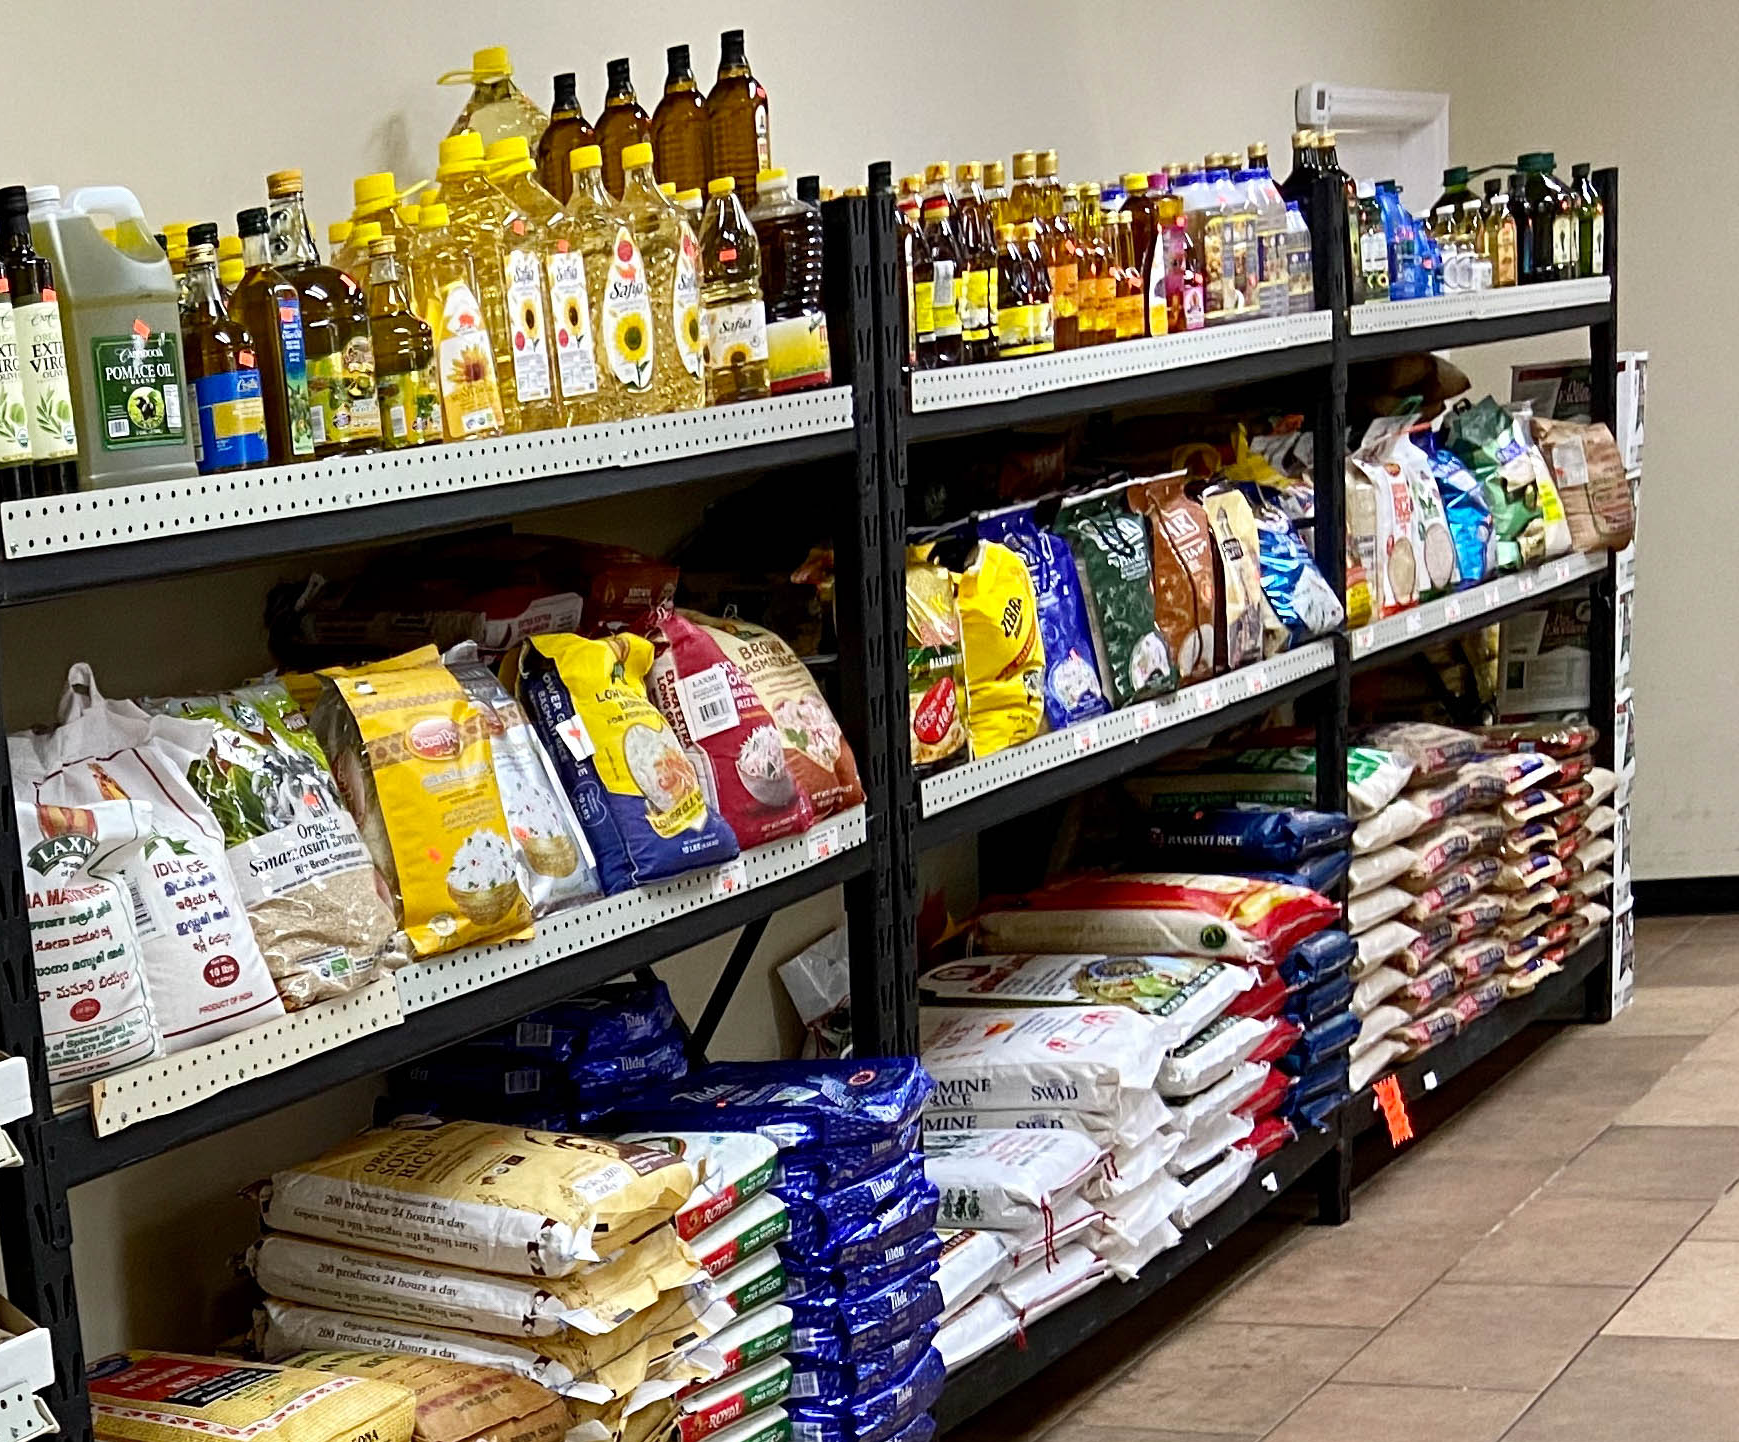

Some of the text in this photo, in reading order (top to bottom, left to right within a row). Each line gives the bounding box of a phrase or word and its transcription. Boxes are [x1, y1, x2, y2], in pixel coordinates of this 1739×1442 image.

[106, 362, 175, 381] POMACE OIL
[999, 598, 1024, 638] ZEBRA
[933, 1078, 1079, 1102] MINE SWAD
[866, 1177, 897, 1201] Tilda
[324, 1194, 343, 1206] 200
[344, 1199, 389, 1216] products
[391, 1206, 405, 1218] 24
[405, 1209, 436, 1225] hours
[446, 1216, 468, 1232] day
[316, 1262, 335, 1275] 200
[335, 1267, 381, 1284] products
[382, 1275, 396, 1286] 24
[397, 1277, 428, 1294] hours
[438, 1284, 459, 1298] day
[885, 1291, 909, 1311] Tilda
[317, 1327, 335, 1339] 200
[336, 1332, 382, 1347] products
[382, 1337, 396, 1348] 24
[397, 1340, 428, 1355] hours
[439, 1347, 459, 1360] day
[709, 1402, 744, 1428] ROYAL
